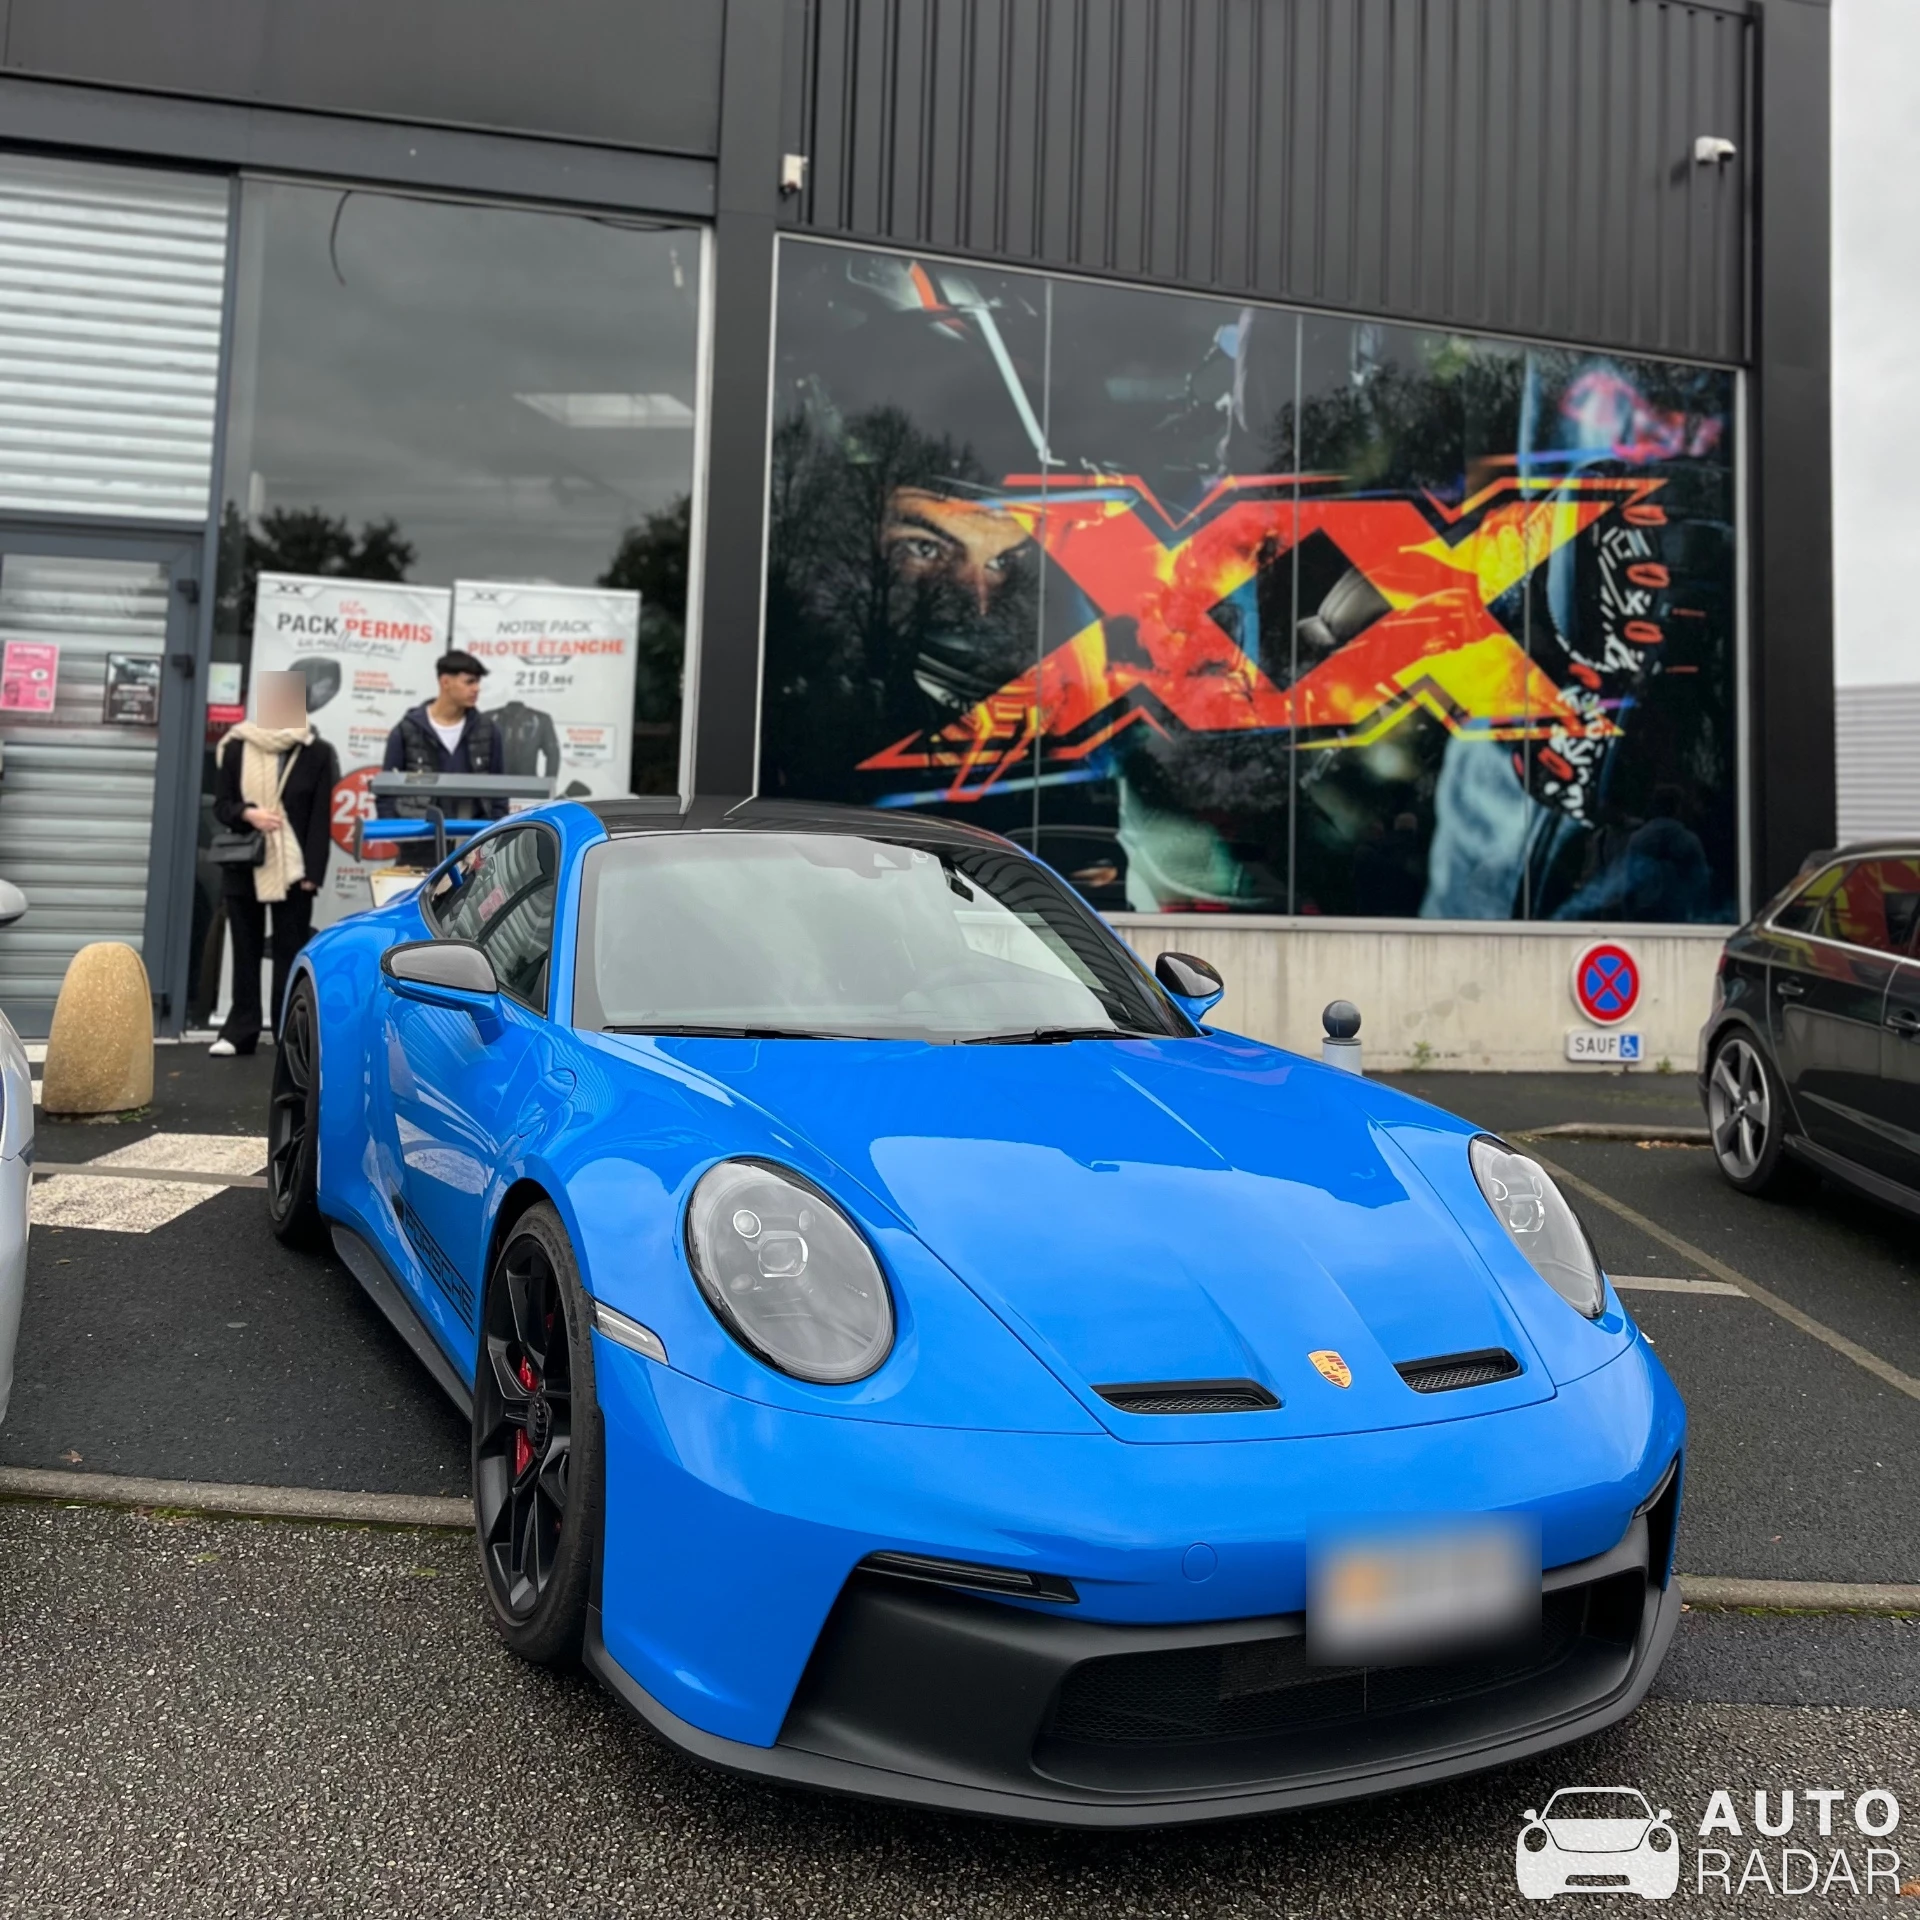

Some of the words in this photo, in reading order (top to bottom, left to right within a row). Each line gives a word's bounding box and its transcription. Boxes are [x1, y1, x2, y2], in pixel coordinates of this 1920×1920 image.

[277, 612, 338, 636] PACK
[345, 618, 432, 644] PERMIS
[497, 620, 546, 634] NOTRE
[550, 620, 594, 633] PACK
[468, 640, 531, 656] PILOTE
[537, 635, 625, 656] ÉTANCHE
[1575, 1037, 1617, 1054] SAUF
[404, 1204, 474, 1323] PORSCHE
